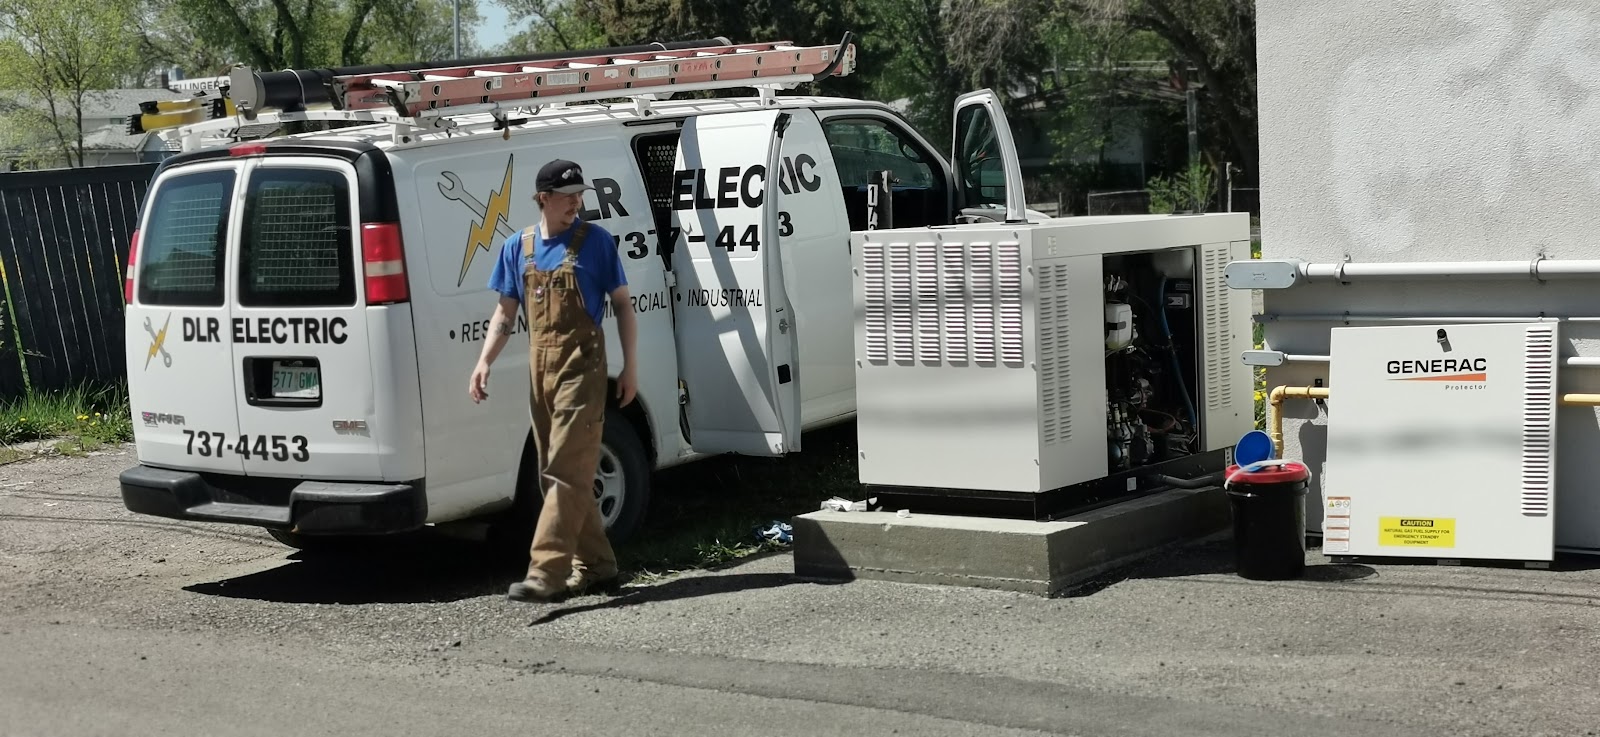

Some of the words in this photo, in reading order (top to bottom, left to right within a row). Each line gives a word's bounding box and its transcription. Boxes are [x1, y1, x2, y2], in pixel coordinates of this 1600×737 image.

[687, 288, 763, 307] INDUSTRIAL
[182, 317, 221, 342] DLR
[231, 317, 348, 344] ELECTRIC
[1387, 358, 1487, 374] GENERAC
[273, 371, 293, 388] 577
